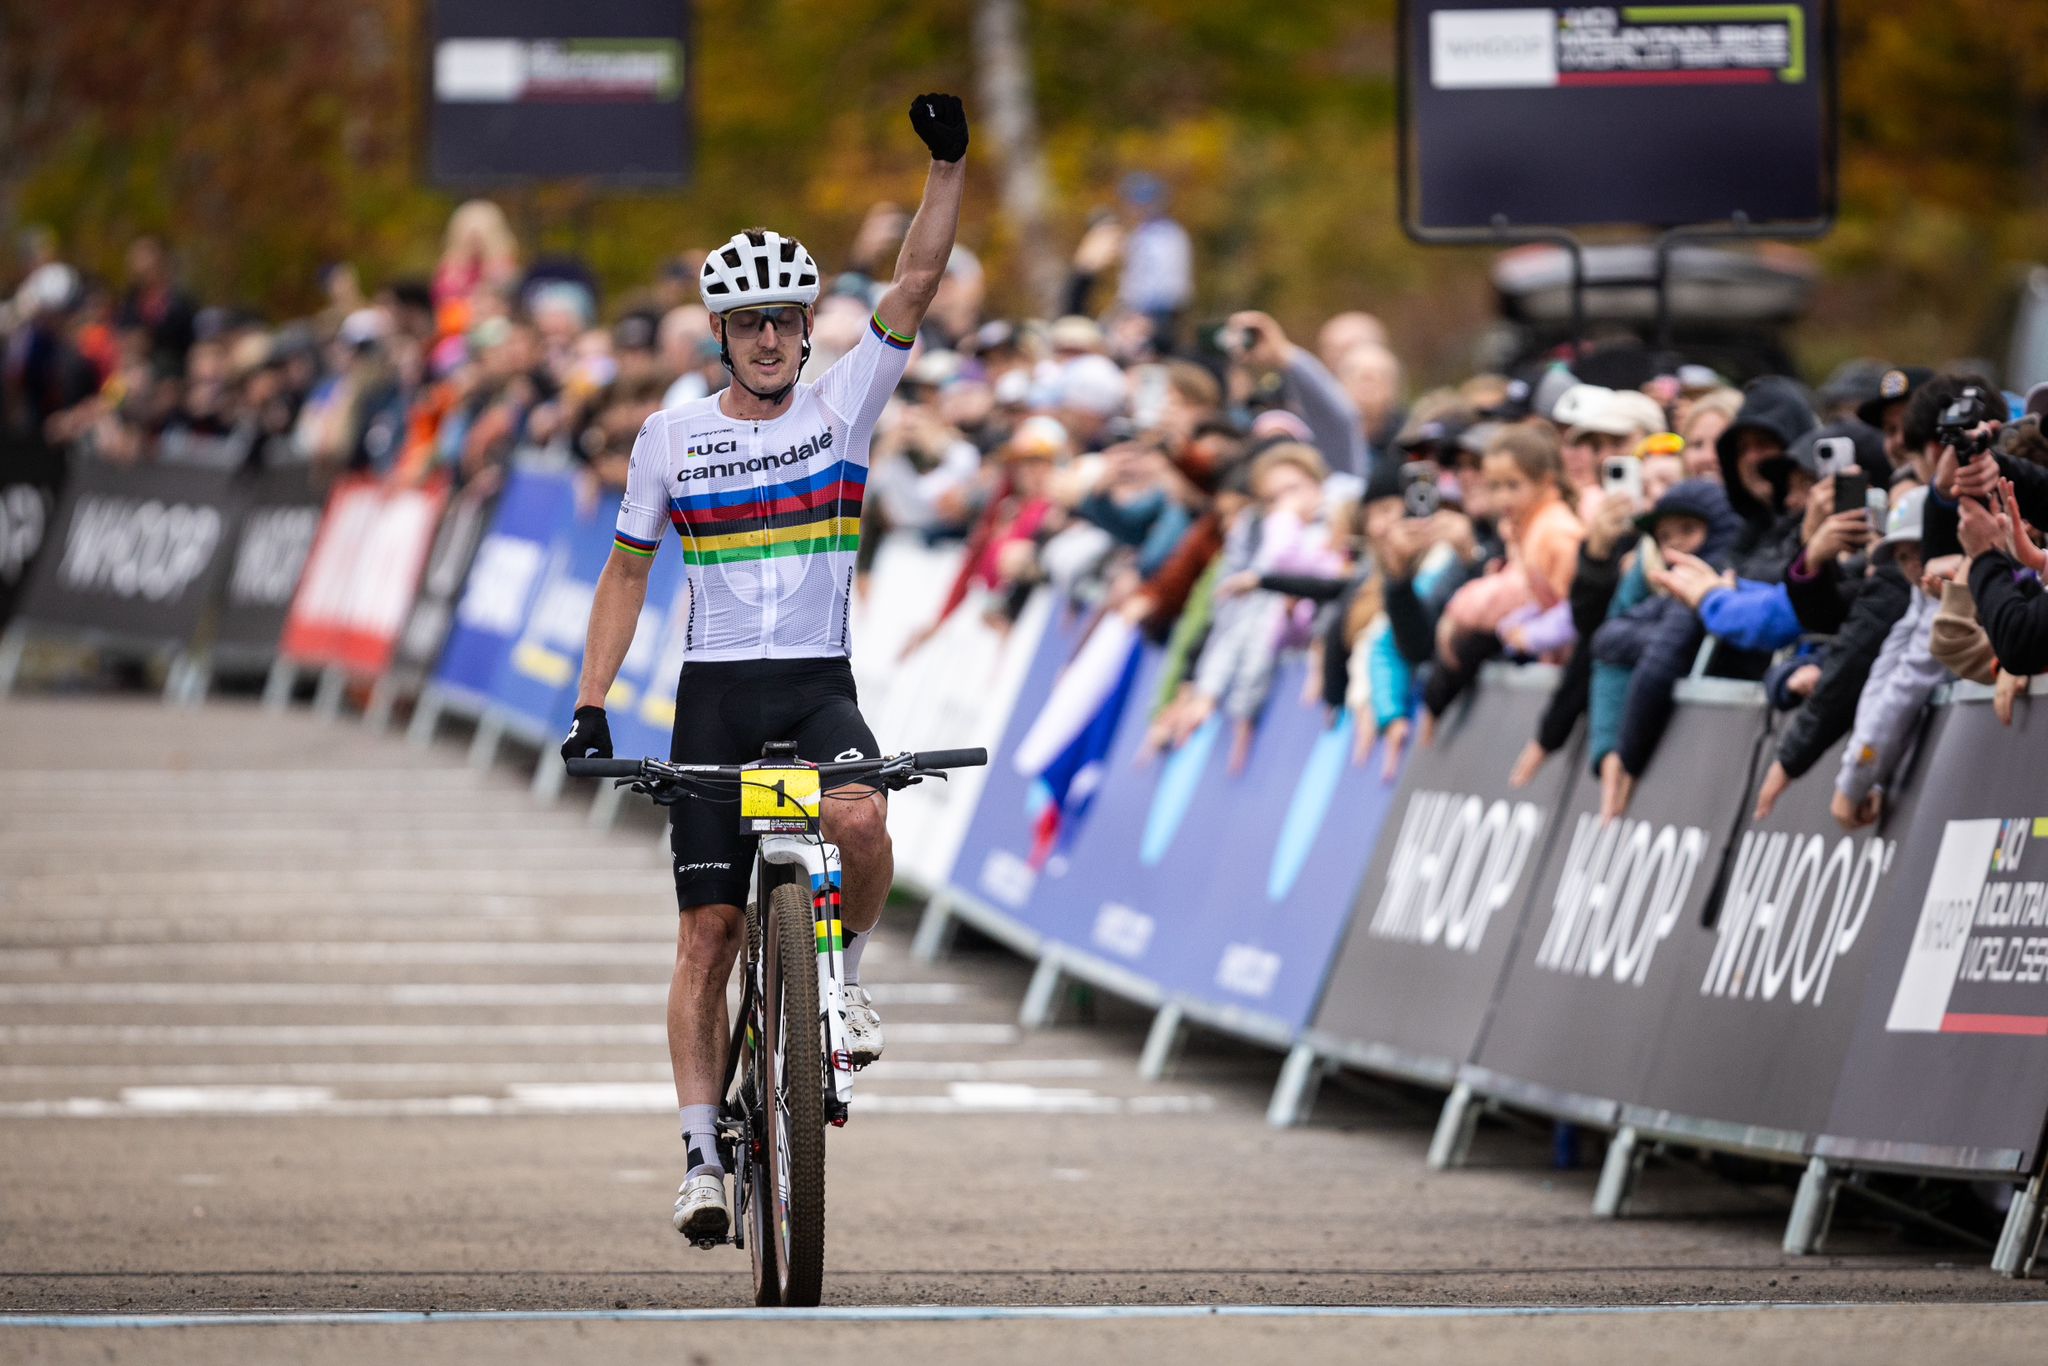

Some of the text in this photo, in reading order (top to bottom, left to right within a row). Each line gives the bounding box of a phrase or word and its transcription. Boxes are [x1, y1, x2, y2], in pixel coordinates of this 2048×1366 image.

[677, 428, 834, 482] cannondale
[696, 440, 737, 456] UCI
[771, 779, 785, 807] 1
[1369, 789, 1540, 953] WHOOP
[1535, 811, 1705, 987] WHOOP
[1700, 829, 1887, 1006] WHOOP
